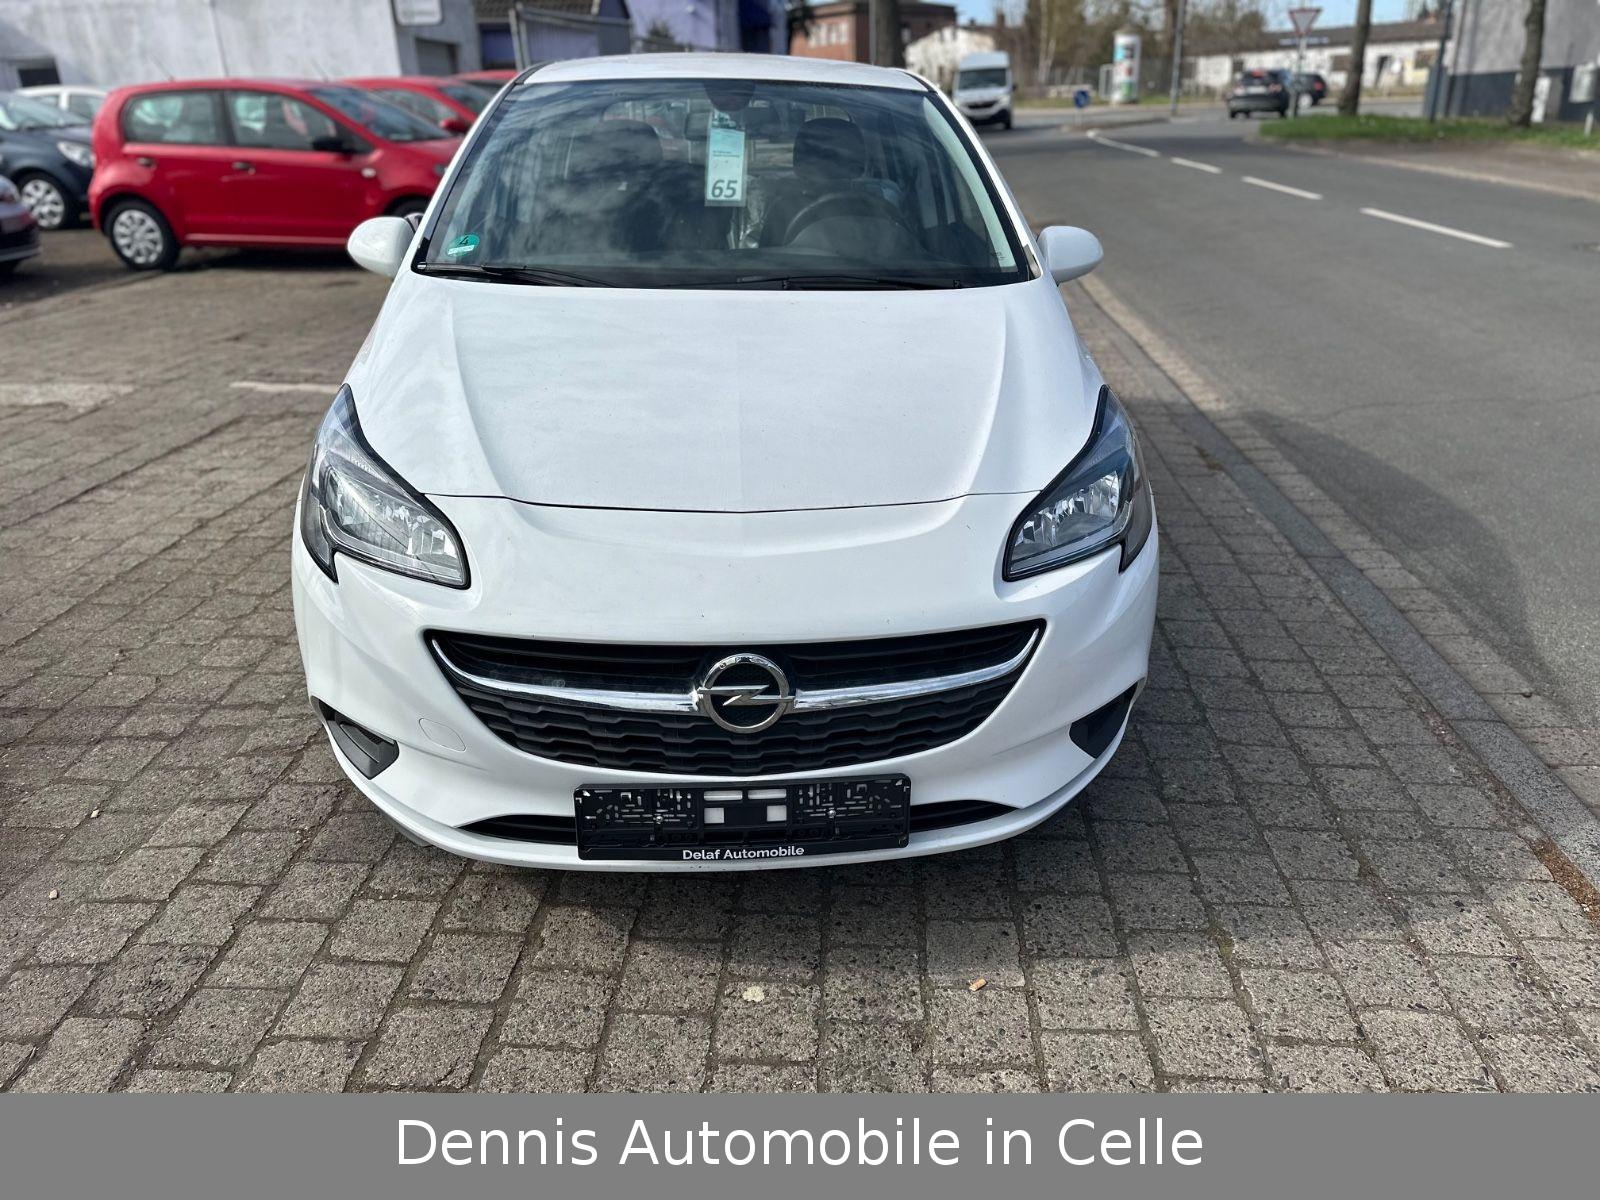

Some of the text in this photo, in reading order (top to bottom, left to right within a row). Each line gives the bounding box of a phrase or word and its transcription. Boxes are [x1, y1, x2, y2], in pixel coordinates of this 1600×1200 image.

[711, 179, 737, 198] 65
[458, 235, 469, 245] 4
[682, 846, 804, 860] Delaf Automobile
